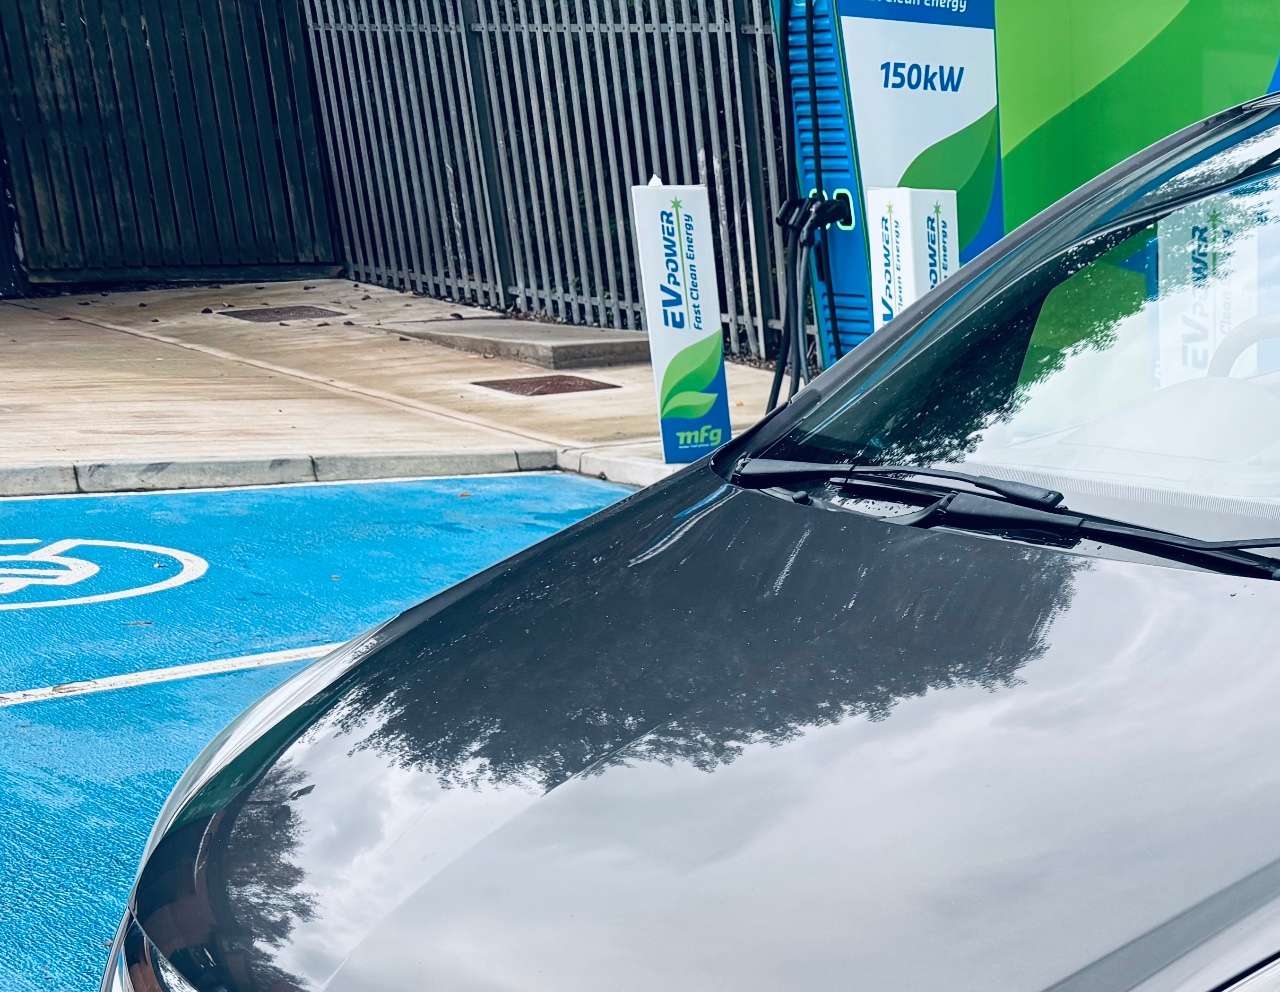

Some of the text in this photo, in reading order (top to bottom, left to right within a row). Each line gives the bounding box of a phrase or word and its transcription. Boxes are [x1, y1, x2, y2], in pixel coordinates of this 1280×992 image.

[880, 61, 965, 92] 150kW
[684, 214, 703, 330] Fast Clean Energy
[675, 425, 722, 447] mfg
